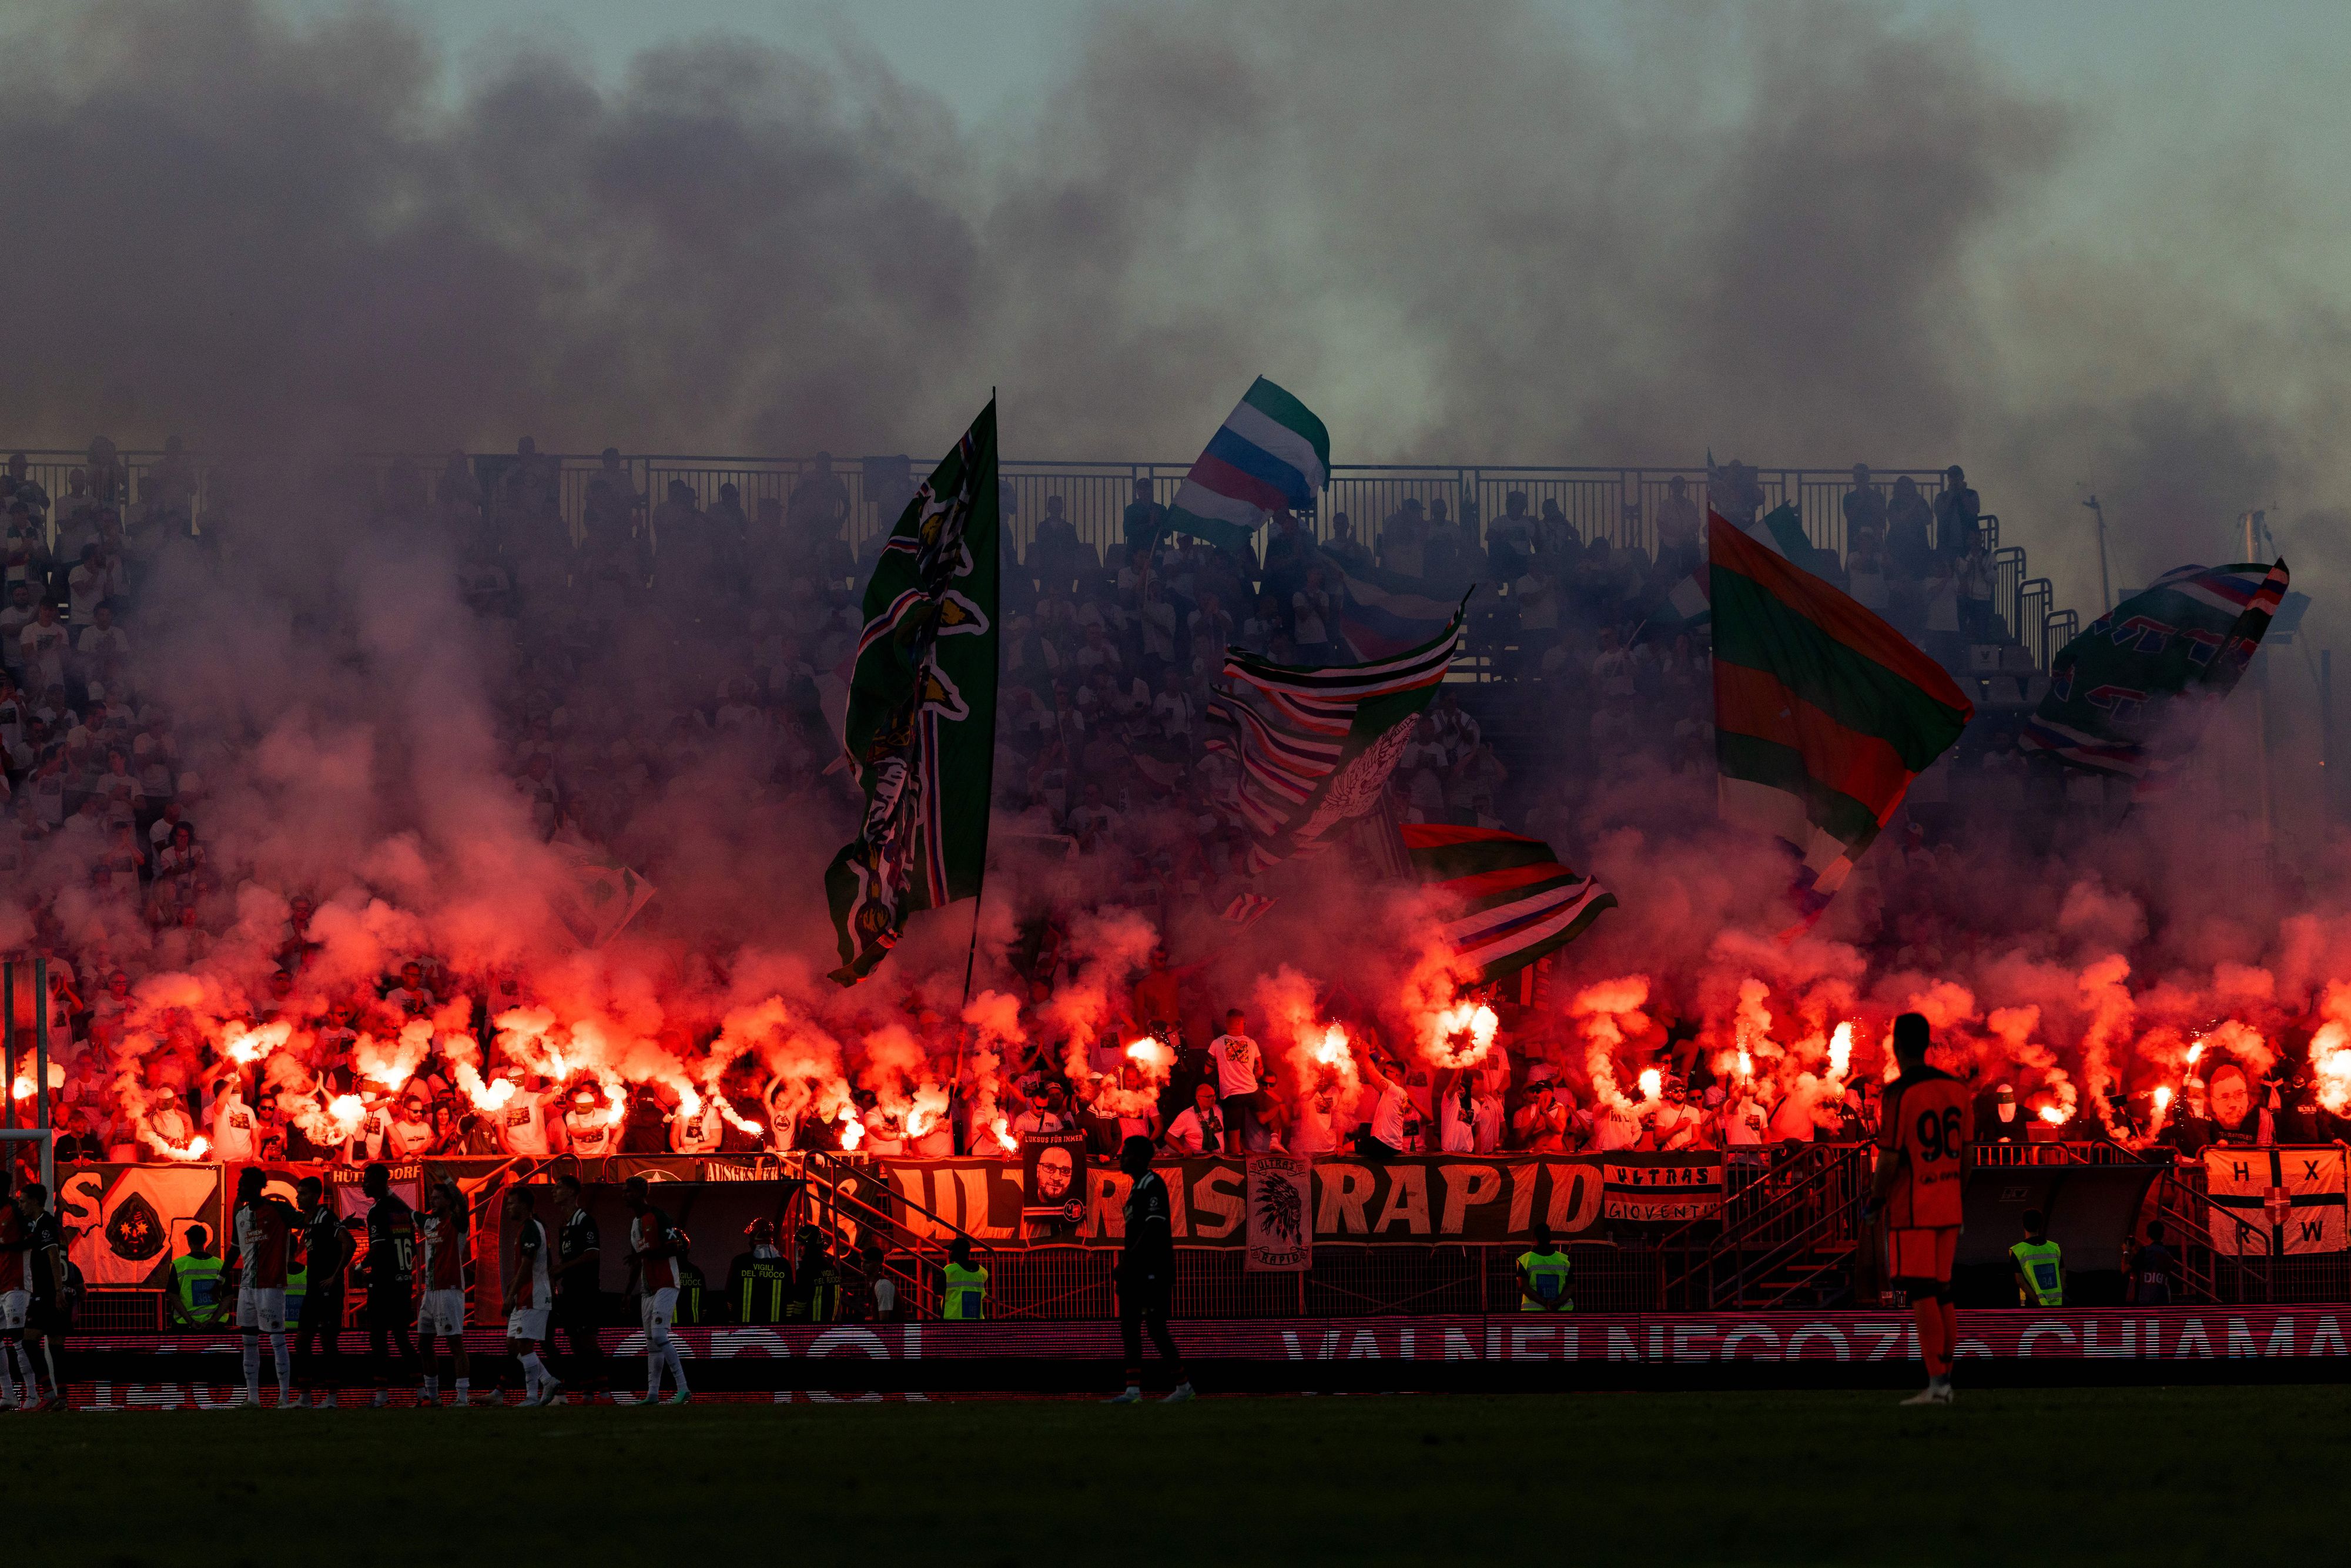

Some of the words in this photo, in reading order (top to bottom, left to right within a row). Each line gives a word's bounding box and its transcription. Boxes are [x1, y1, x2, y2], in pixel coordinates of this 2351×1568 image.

[1050, 1135, 1062, 1143] FÜR
[1063, 1134, 1083, 1143] IMMER
[1918, 1107, 1961, 1162] 96
[1257, 1159, 1294, 1170] ULTRAS
[2233, 1161, 2249, 1181] H
[2303, 1160, 2320, 1180] X
[1617, 1167, 1709, 1185] ULTRAS
[1312, 1162, 1604, 1235] RAPID
[2301, 1221, 2323, 1241] W
[394, 1238, 412, 1271] 16
[1261, 1253, 1300, 1264] RAPID
[759, 1271, 785, 1279] FUOCO
